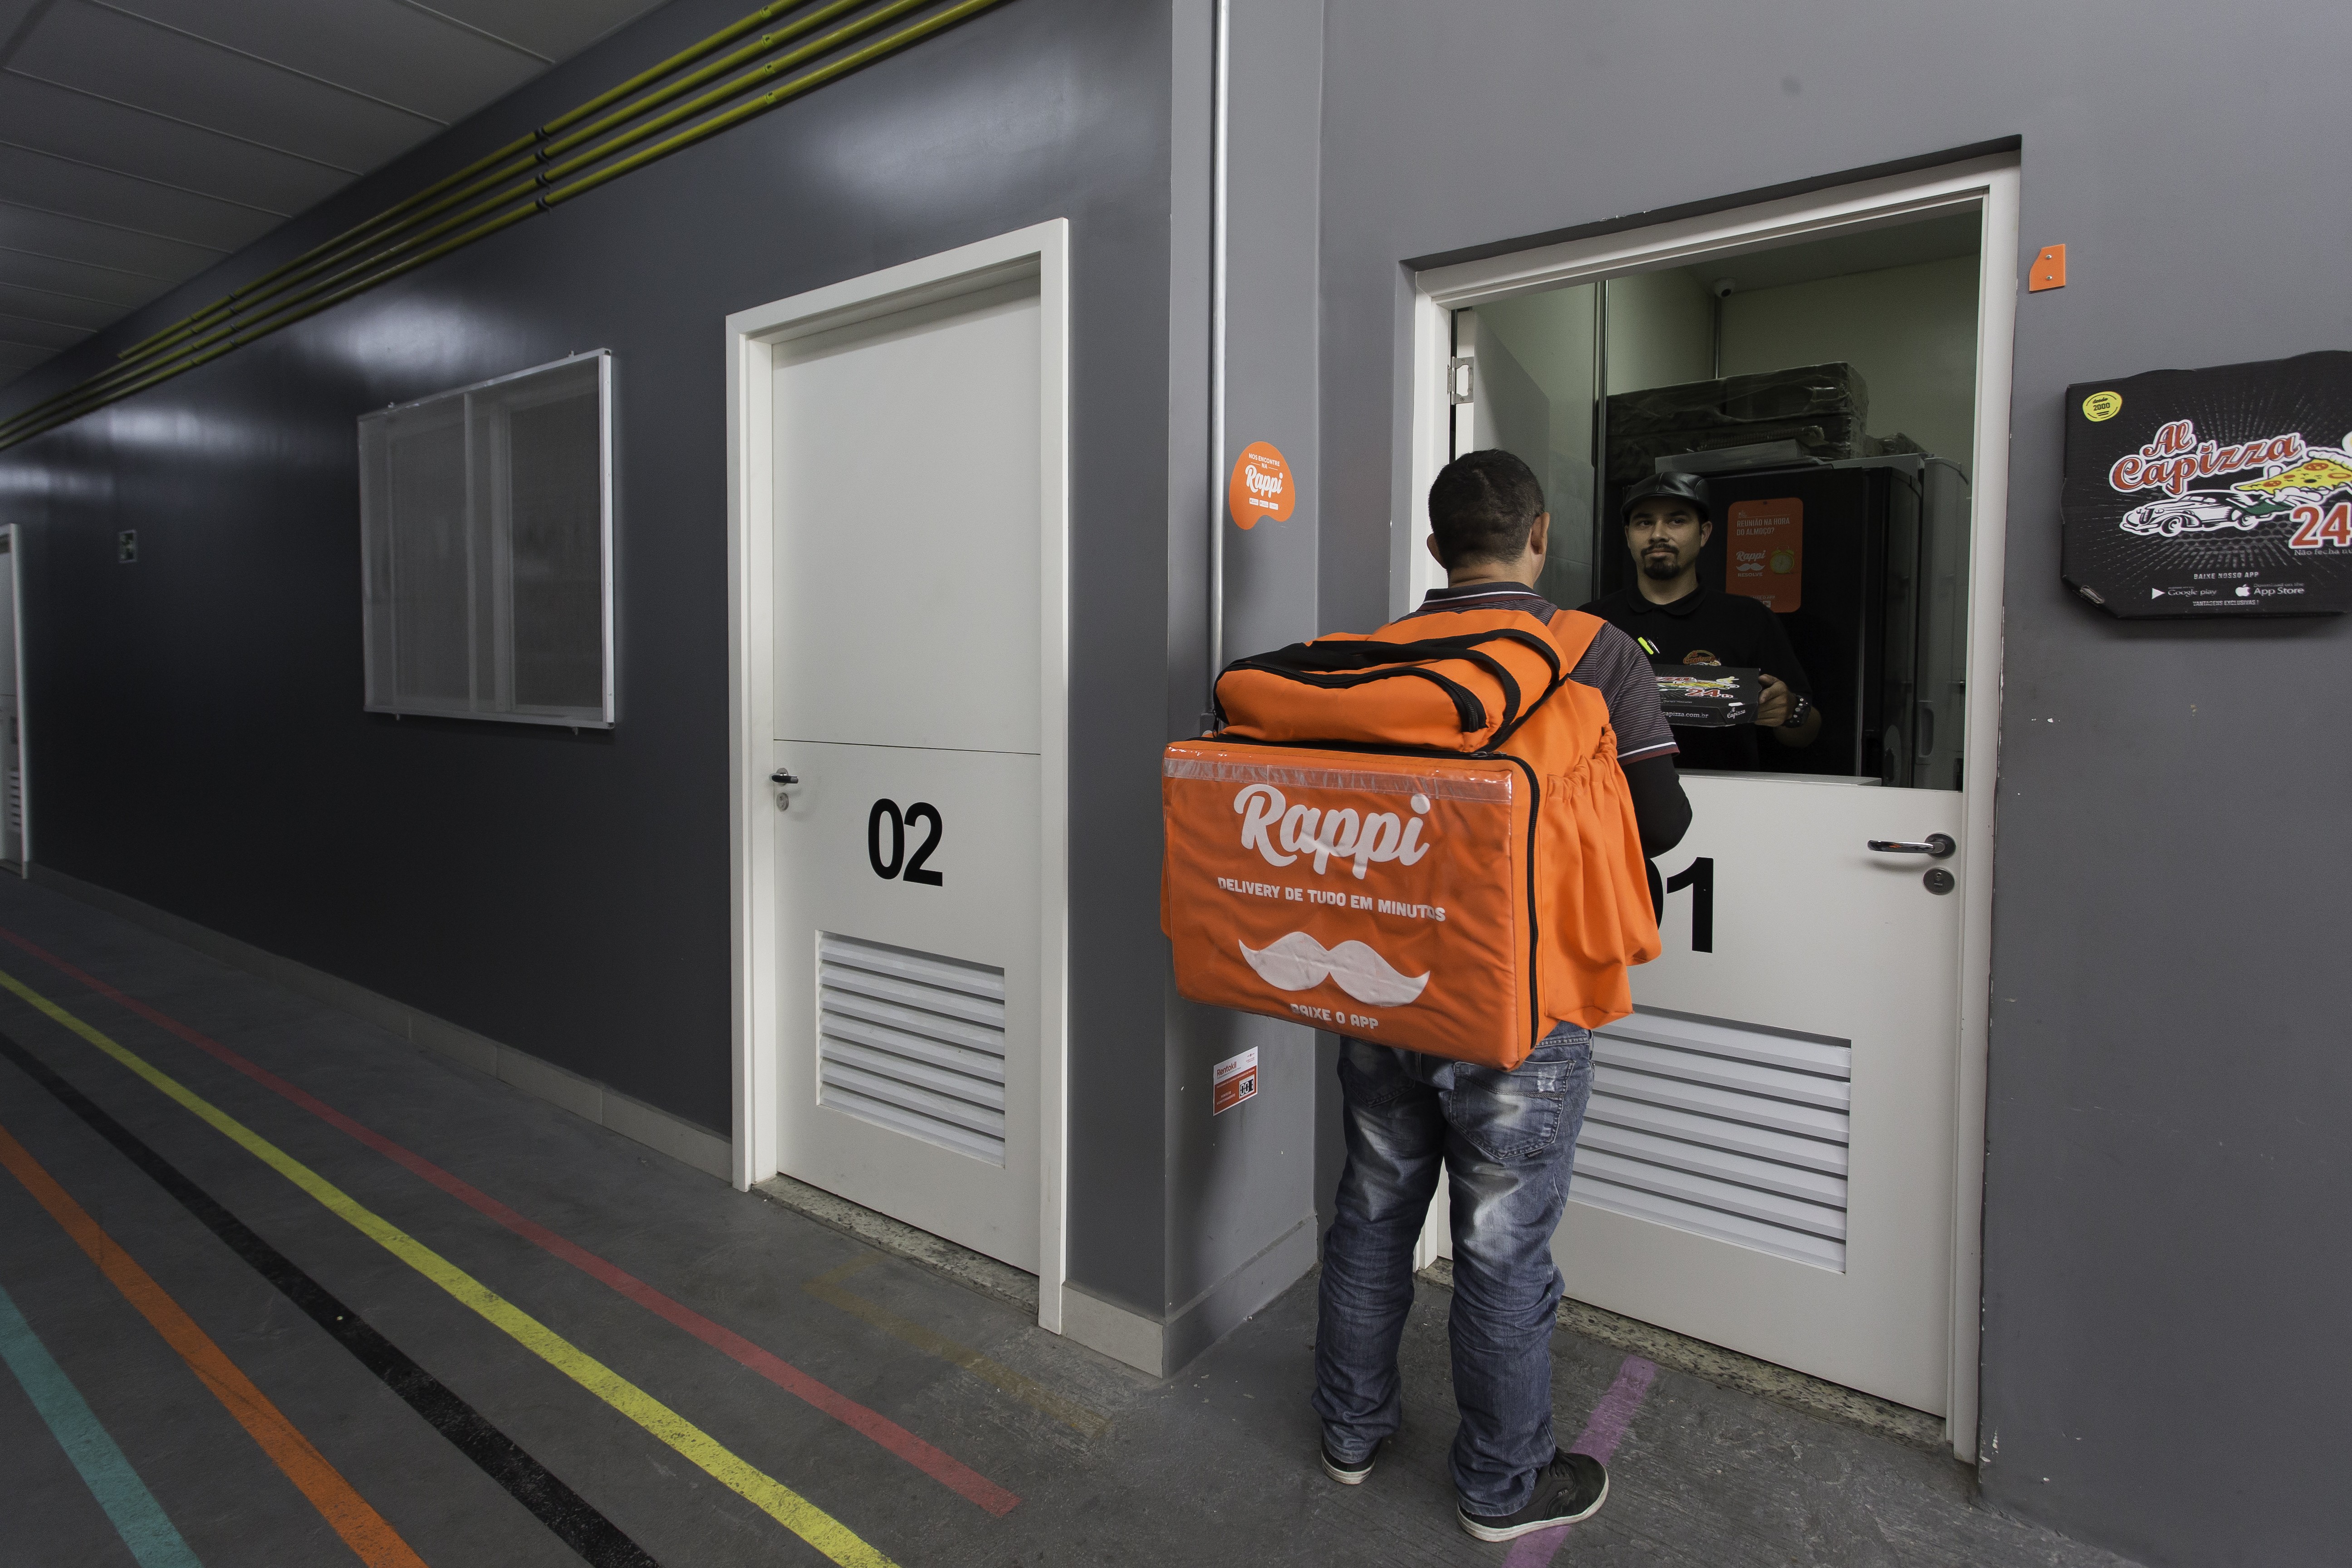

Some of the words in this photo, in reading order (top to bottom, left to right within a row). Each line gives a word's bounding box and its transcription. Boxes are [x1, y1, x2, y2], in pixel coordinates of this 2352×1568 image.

[2093, 402, 2110, 411] 2000
[2140, 421, 2194, 458] Al
[1258, 456, 1280, 466] ENCONTRE
[2110, 433, 2305, 496] Capizza
[1245, 465, 1283, 498] Rappi
[1737, 518, 1762, 527] REUNIÃO
[1746, 527, 1774, 535] ALMOÇO?
[1736, 550, 1766, 561] Rappi
[2254, 588, 2275, 596] App
[1233, 784, 1431, 879] Rappi
[868, 798, 943, 887] 02
[1217, 877, 1280, 899] DELIVERY
[1285, 887, 1303, 902] DE
[1307, 889, 1346, 907] TUDO
[1350, 895, 1373, 911] EM
[1378, 900, 1446, 922] MINUTOS
[1290, 1004, 1332, 1021] BAIXE
[1336, 1011, 1346, 1024] O
[1350, 1014, 1379, 1029] APP
[1217, 1061, 1237, 1077] Rentokil
[1240, 1079, 1253, 1096] 001
